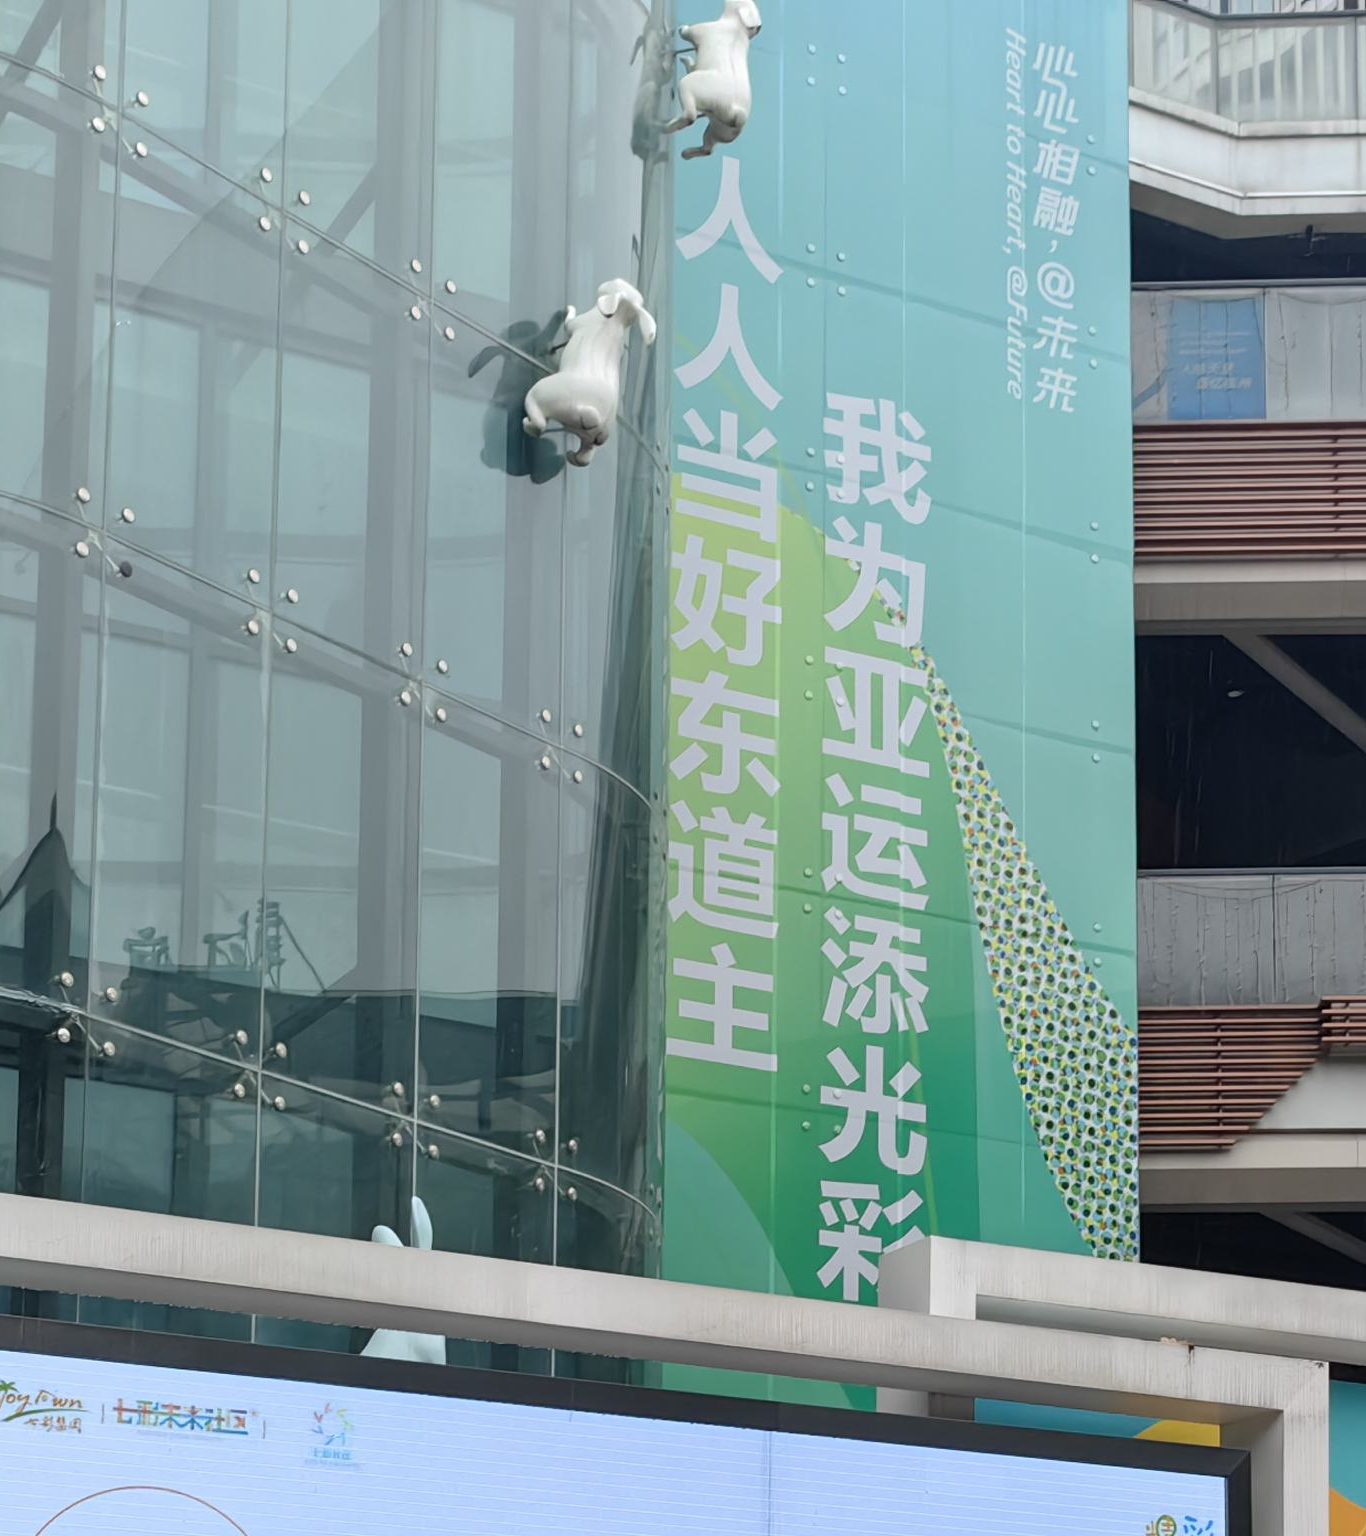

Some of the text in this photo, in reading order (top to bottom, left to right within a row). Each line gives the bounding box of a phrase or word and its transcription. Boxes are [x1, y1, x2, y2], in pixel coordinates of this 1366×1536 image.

[1005, 27, 1027, 116] Heart
[1006, 123, 1026, 155] to
[1002, 161, 1027, 255] Heart,
[667, 156, 784, 1072] 人人当好东道主
[818, 392, 933, 1302] 我为亚运添光彩
